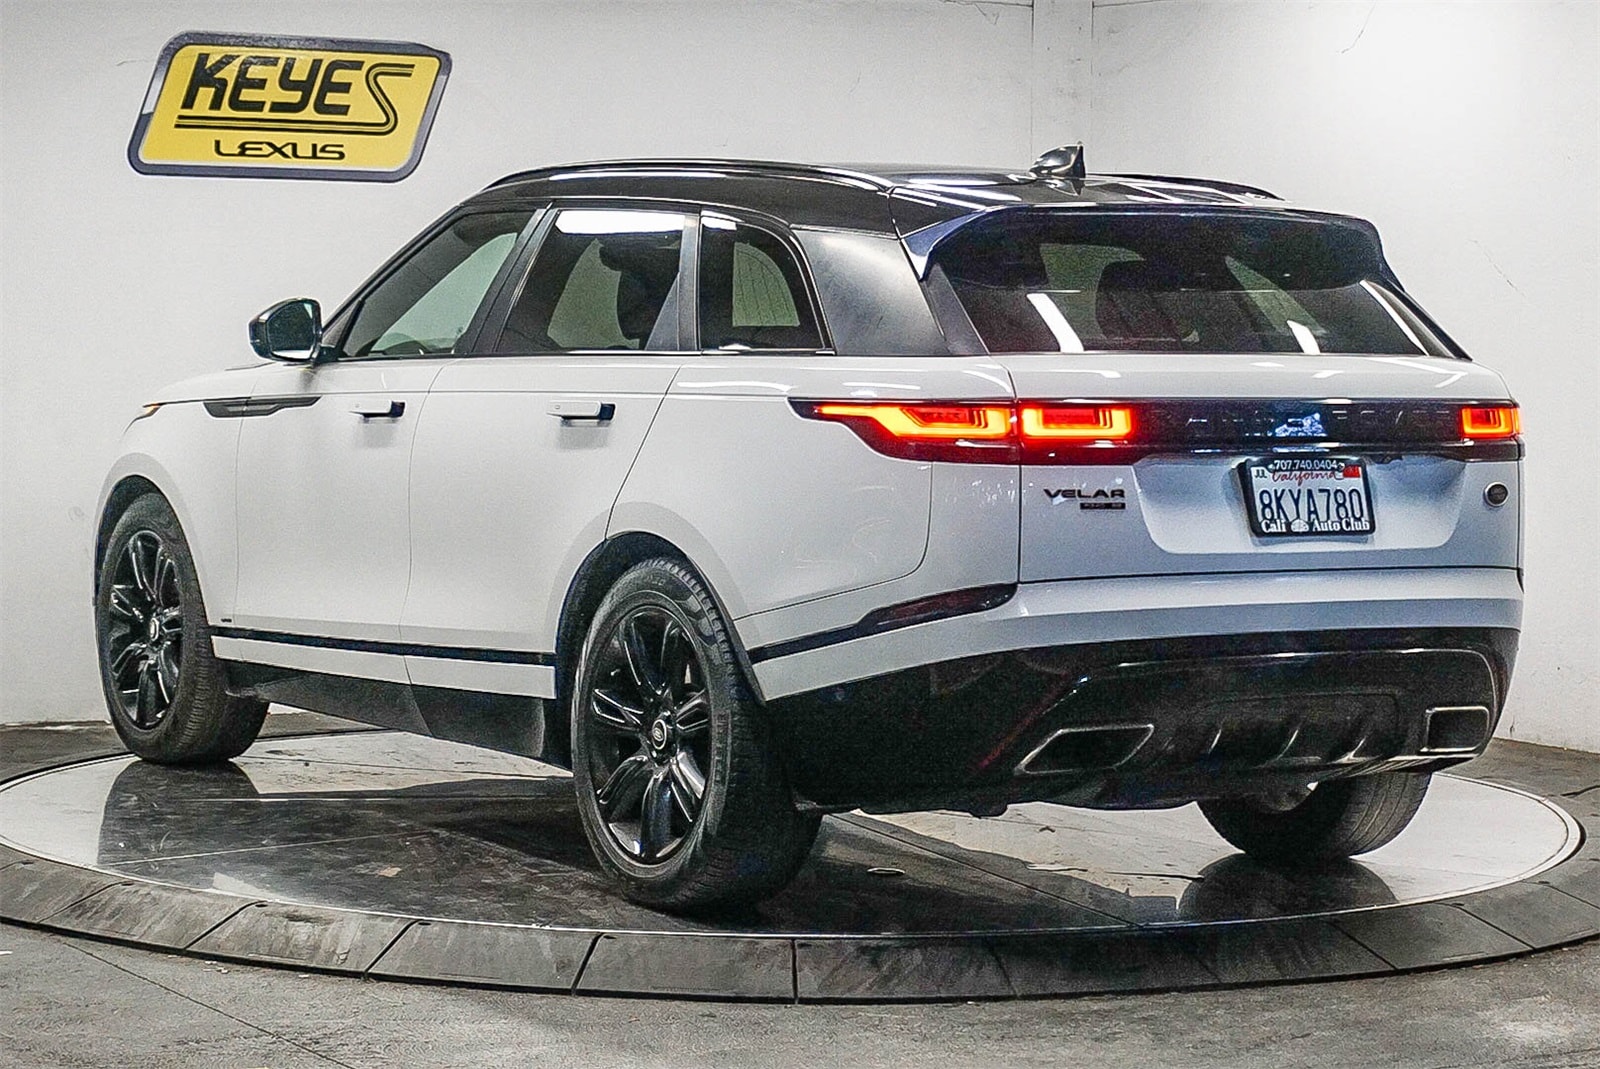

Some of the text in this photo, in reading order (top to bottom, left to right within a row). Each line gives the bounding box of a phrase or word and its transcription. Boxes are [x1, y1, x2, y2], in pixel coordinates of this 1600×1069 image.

[177, 51, 416, 136] KEYES
[213, 139, 346, 161] LEXUS
[1274, 460, 1337, 470] 707.740.0404
[1271, 470, 1345, 486] California
[1043, 488, 1126, 499] VELAR
[1259, 488, 1364, 521] 8KYA780
[1261, 518, 1370, 533] Cali Auto Club
